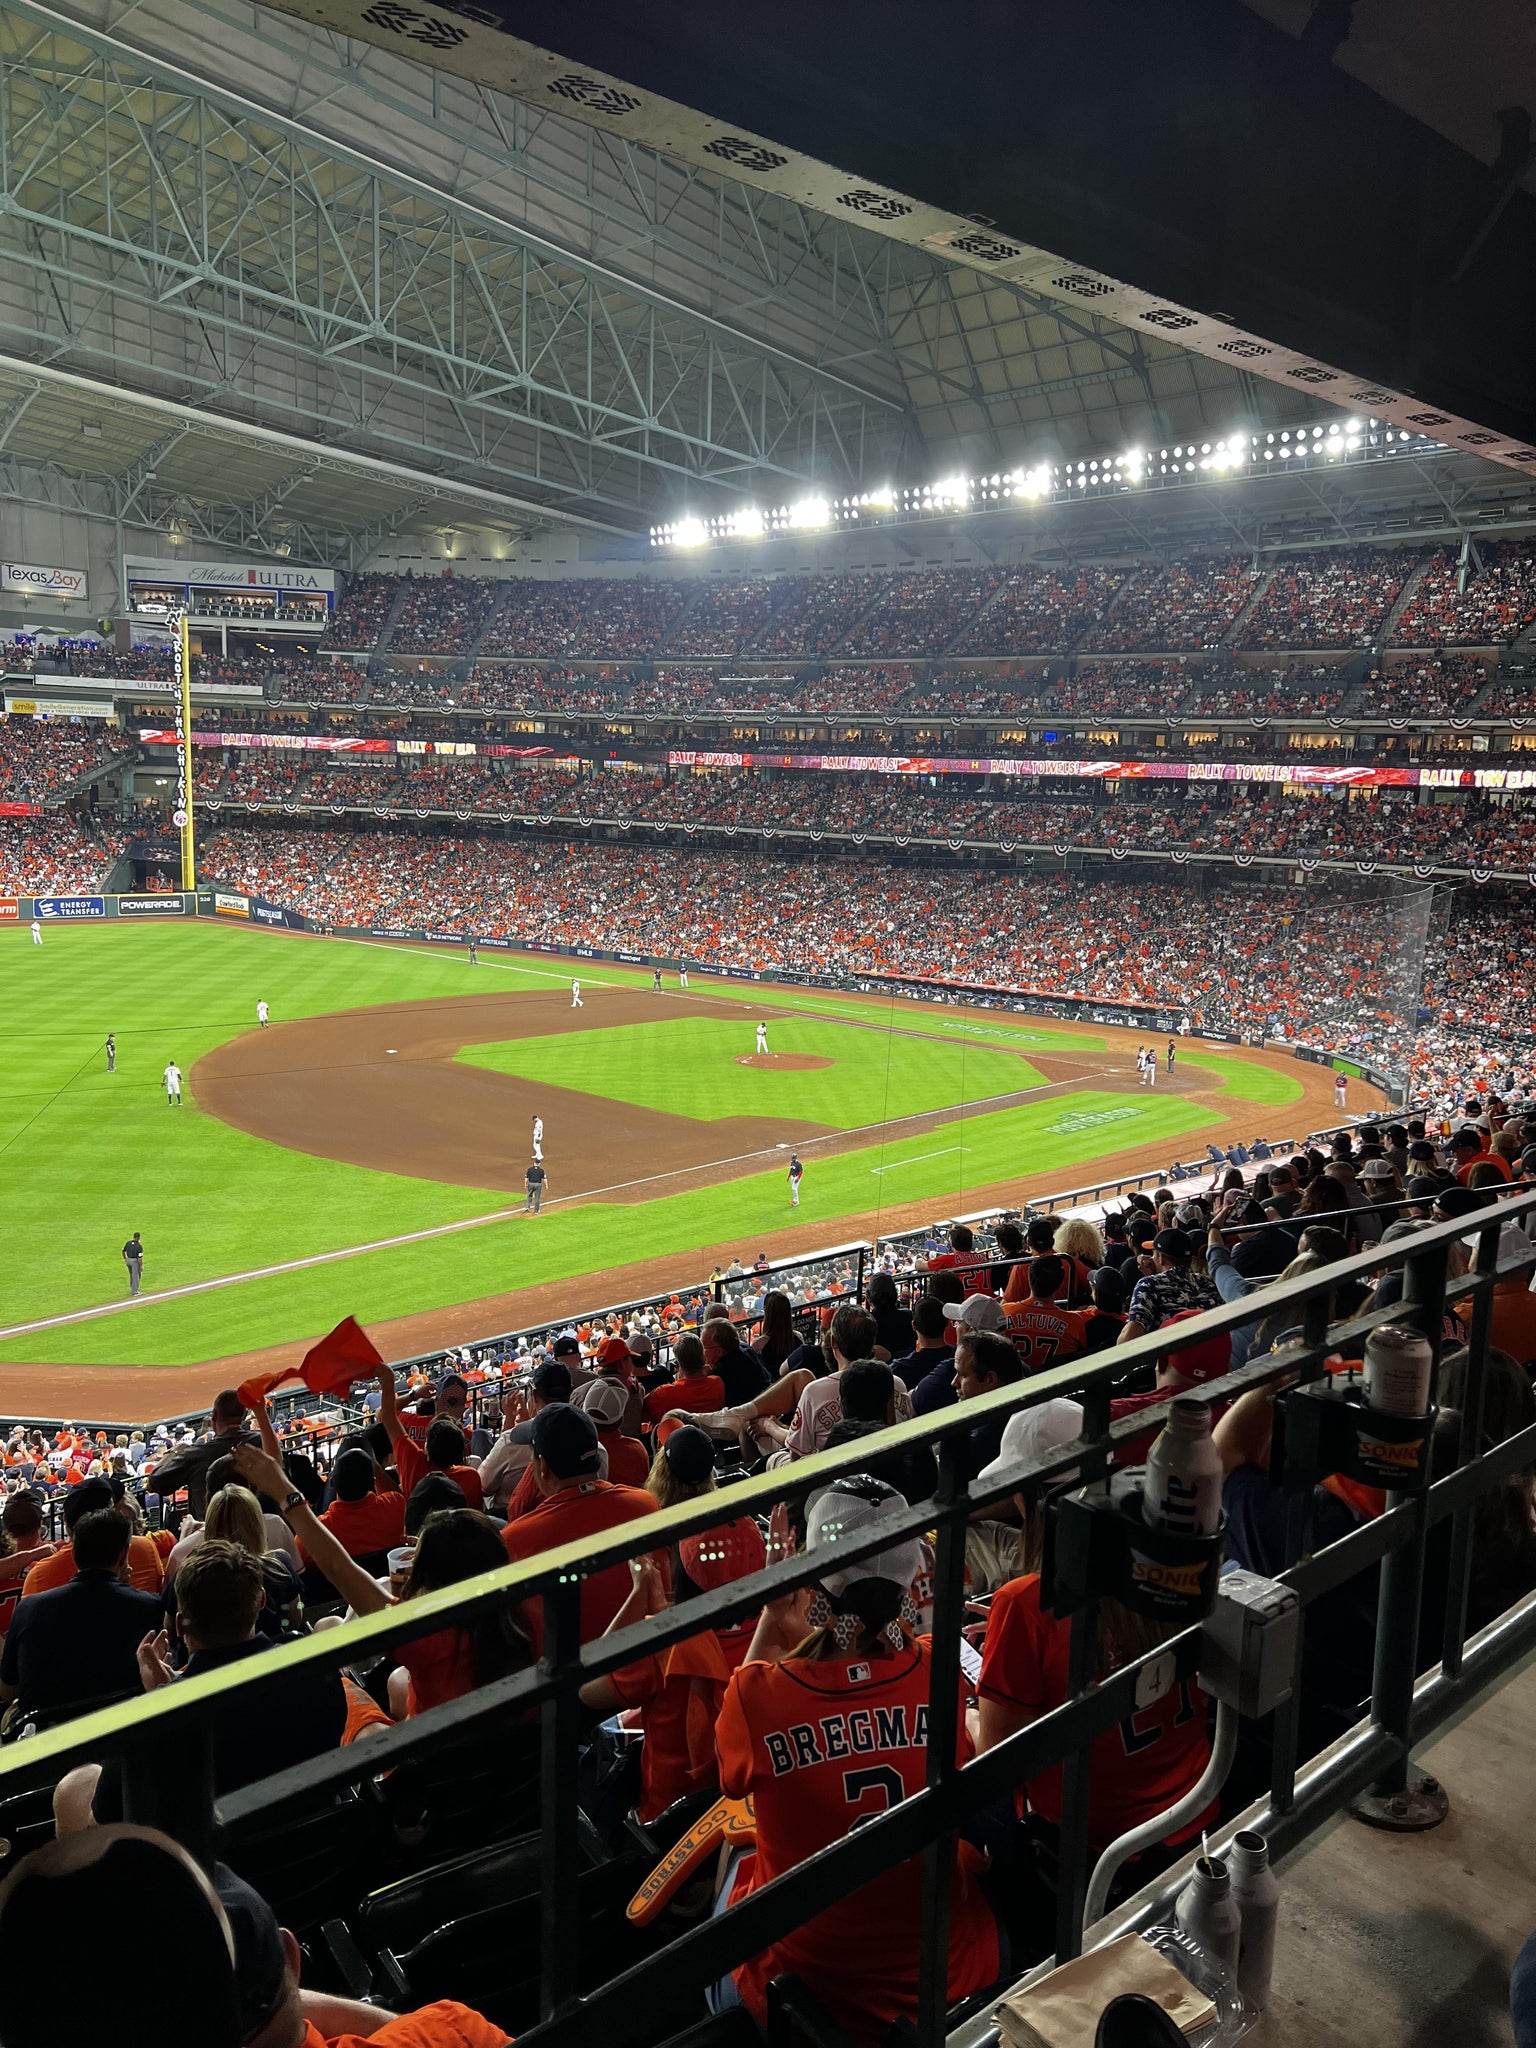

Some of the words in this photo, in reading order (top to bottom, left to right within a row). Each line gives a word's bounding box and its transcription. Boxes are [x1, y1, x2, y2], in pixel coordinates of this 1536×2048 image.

[5, 564, 47, 583] Texas
[54, 570, 81, 591] Bay
[188, 568, 244, 582] Michelob
[260, 572, 318, 587] ULTRA
[40, 704, 108, 712] SmileGeneration.com
[175, 705, 184, 739] THA
[222, 733, 252, 746] RALLY
[261, 734, 306, 748] TOWELS!
[396, 740, 425, 754] RALLY
[669, 751, 696, 764] RALLY
[704, 752, 742, 766] TOWELS!
[821, 756, 849, 769] RALLY
[856, 756, 899, 771] TOWELS!
[176, 744, 187, 808] CHIKIN
[991, 760, 1022, 774] RALLY
[1031, 760, 1079, 776] TOWELS!
[1188, 764, 1226, 779] RALLY
[1235, 764, 1293, 781] TOWELS!
[1420, 769, 1463, 786] RALLY
[60, 901, 91, 909] ENERGY
[120, 901, 180, 909] POWERADE
[257, 908, 283, 919] POSTSEASON
[1006, 1313, 1068, 1336] ALTUVE
[1011, 1334, 1060, 1364] 27
[1148, 1665, 1163, 1694] 4
[764, 1704, 930, 1777] BREGMA
[697, 1810, 727, 1835] GO
[641, 1838, 695, 1900] ASTROS
